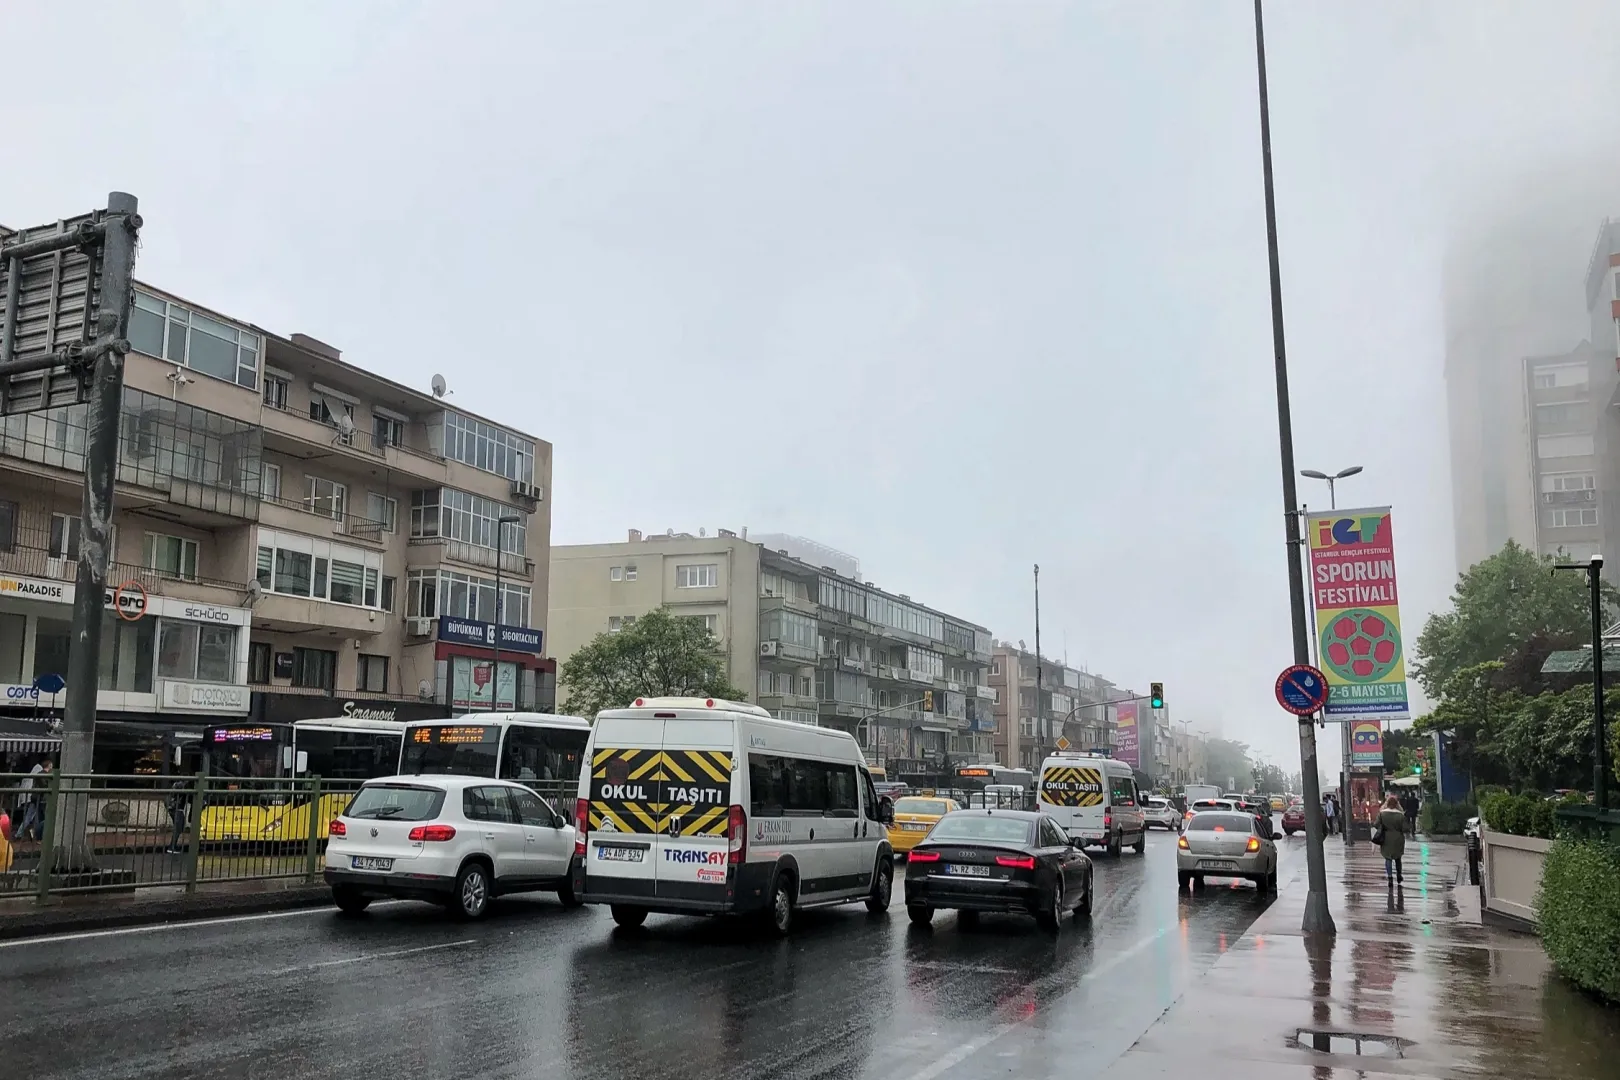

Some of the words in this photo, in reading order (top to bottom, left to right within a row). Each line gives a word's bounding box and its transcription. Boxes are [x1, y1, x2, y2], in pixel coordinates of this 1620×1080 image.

[1316, 559, 1394, 584] SPORUN
[1318, 581, 1395, 605] FESTİVALİ
[185, 607, 229, 621] SCHÜCO
[448, 620, 483, 637] BÜYÜKKAYA
[502, 628, 539, 645] SİGORTACILIK
[1329, 686, 1349, 699] 2-6
[1351, 683, 1403, 697] MAYIS'TA
[341, 701, 397, 720] Seramoni
[601, 784, 648, 800] OKUL
[667, 787, 722, 806] TAŞITI
[1046, 782, 1069, 790] OKUL
[1075, 783, 1099, 792] TAŞITI
[356, 856, 364, 866] 34
[603, 848, 613, 858] 34
[628, 850, 641, 860] 534
[663, 848, 727, 866] TRANSAY
[950, 865, 958, 873] 34
[960, 866, 969, 874] RZ
